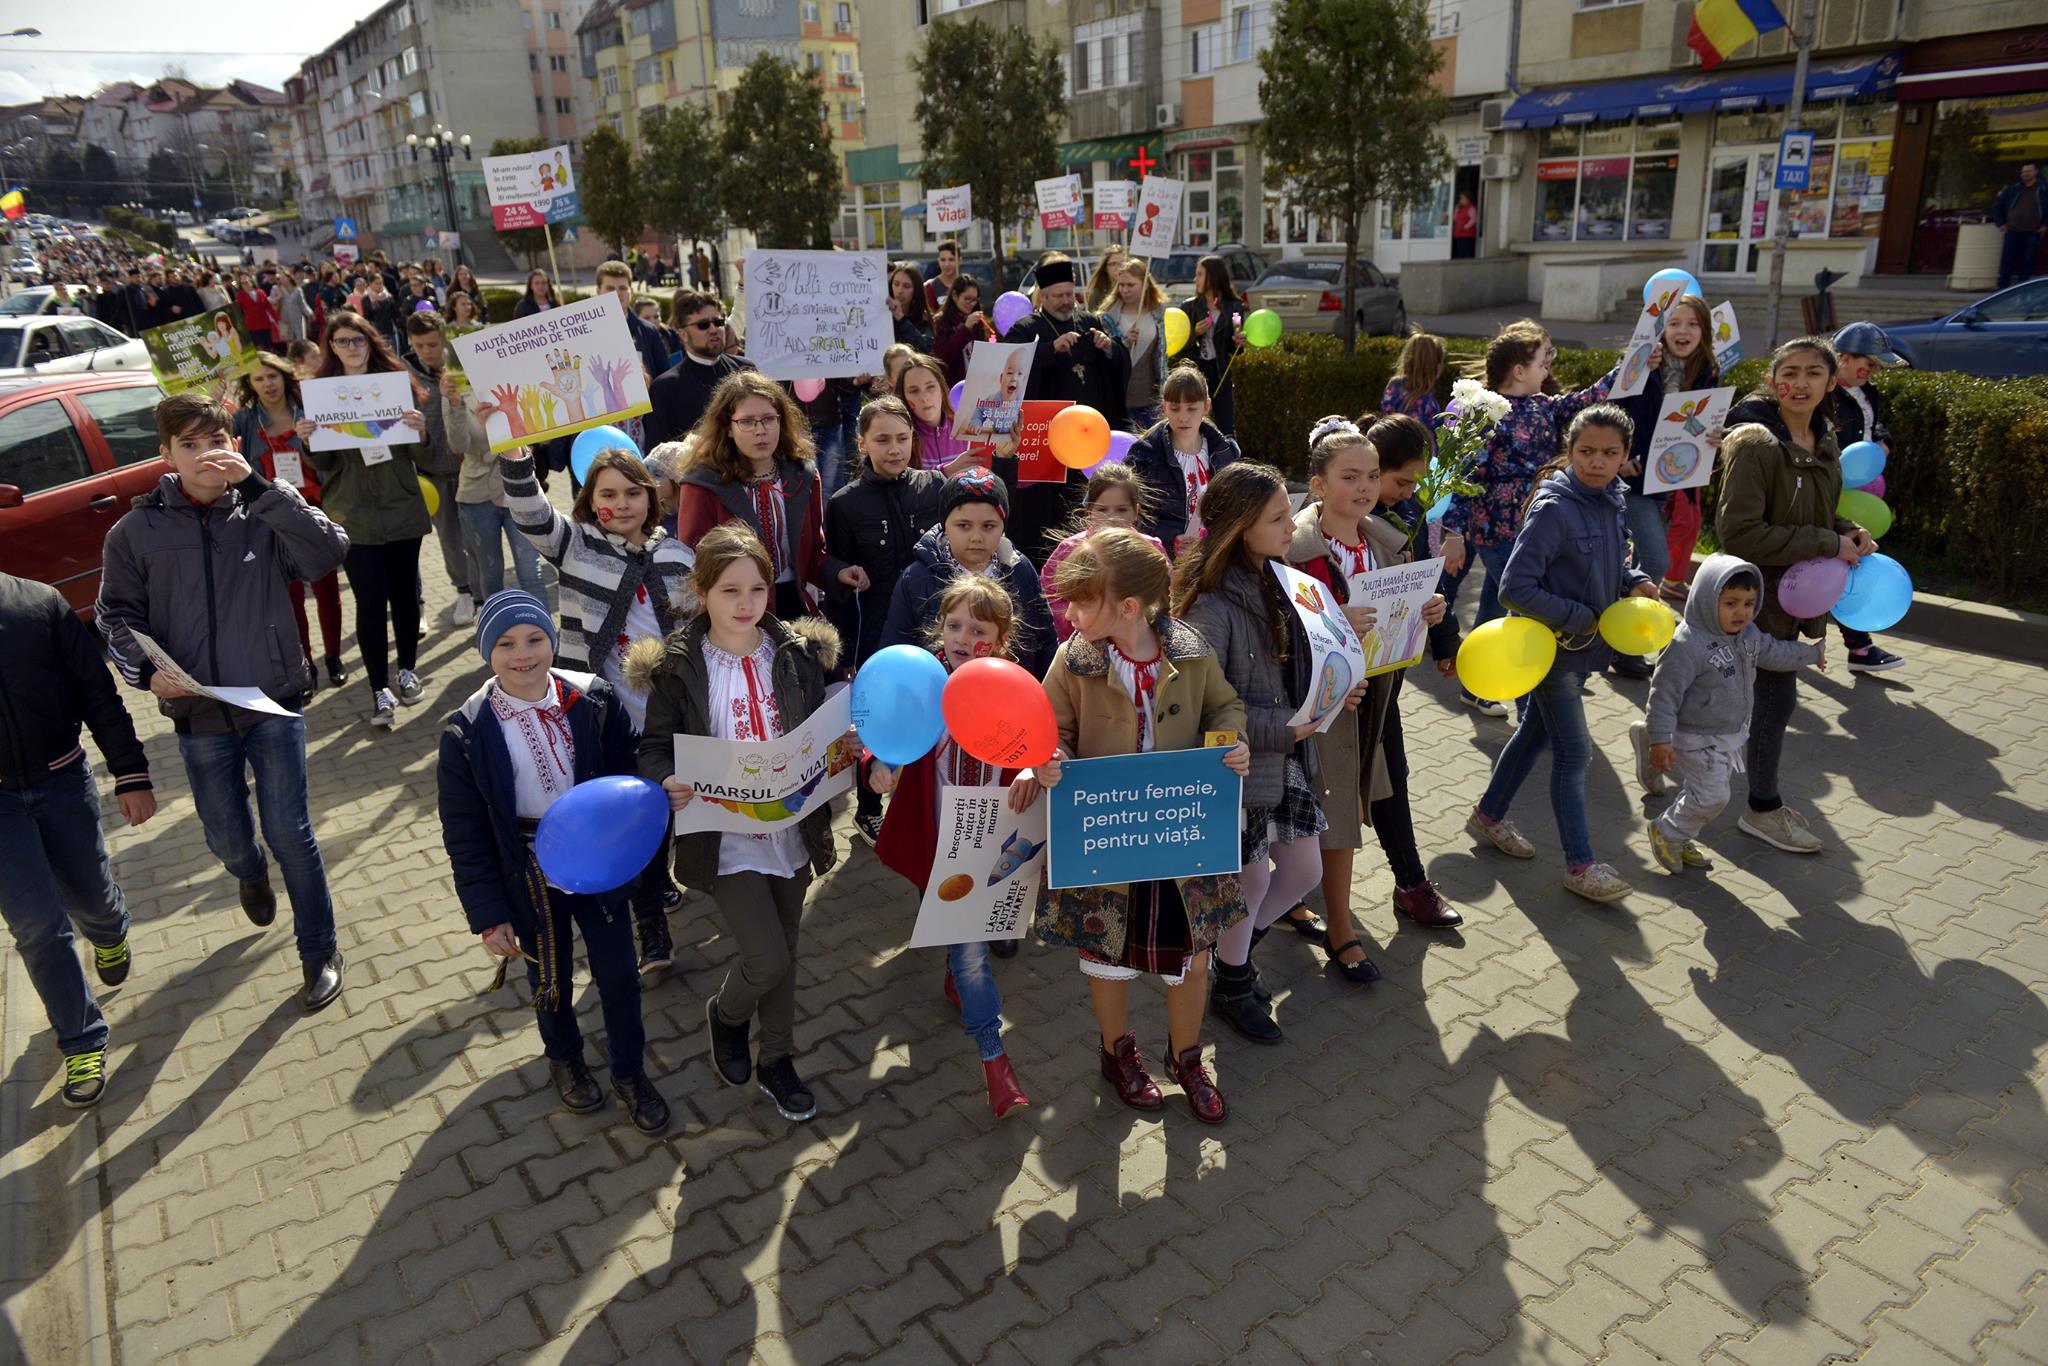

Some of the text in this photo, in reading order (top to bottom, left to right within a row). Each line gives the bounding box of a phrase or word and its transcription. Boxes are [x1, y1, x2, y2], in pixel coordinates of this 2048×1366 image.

[1782, 170, 1804, 183] TAXI
[504, 207, 517, 216] 24
[162, 325, 203, 342] Femeile
[474, 333, 509, 354] AJUTĂ
[509, 324, 548, 343] MAMA
[560, 306, 606, 328] COPILUL!
[496, 323, 593, 359] EI DEPIND DE TINE.
[314, 411, 360, 423] MARȘUL
[375, 405, 404, 420] VIAȚĂ
[976, 398, 1000, 408] Inima
[996, 419, 1004, 428] la
[1022, 438, 1028, 446] o
[1031, 435, 1040, 446] zi
[1371, 590, 1378, 600] EI
[1377, 586, 1400, 599] DEPIND
[1400, 584, 1410, 594] DE
[1004, 744, 1028, 764] 2017
[694, 752, 828, 802] MARȘUL pentru VIAȚ
[1074, 780, 1217, 806] Pentru femeie,
[948, 798, 966, 860] Descoperiți
[964, 798, 977, 840] viața în
[974, 798, 988, 849] pântecele
[988, 798, 1000, 835] mamei
[1083, 802, 1206, 832] pentru copil,
[1084, 825, 1206, 854] pentru viață.
[986, 900, 1004, 933] LĂSAȚI
[1006, 886, 1028, 931] PE MARTE
